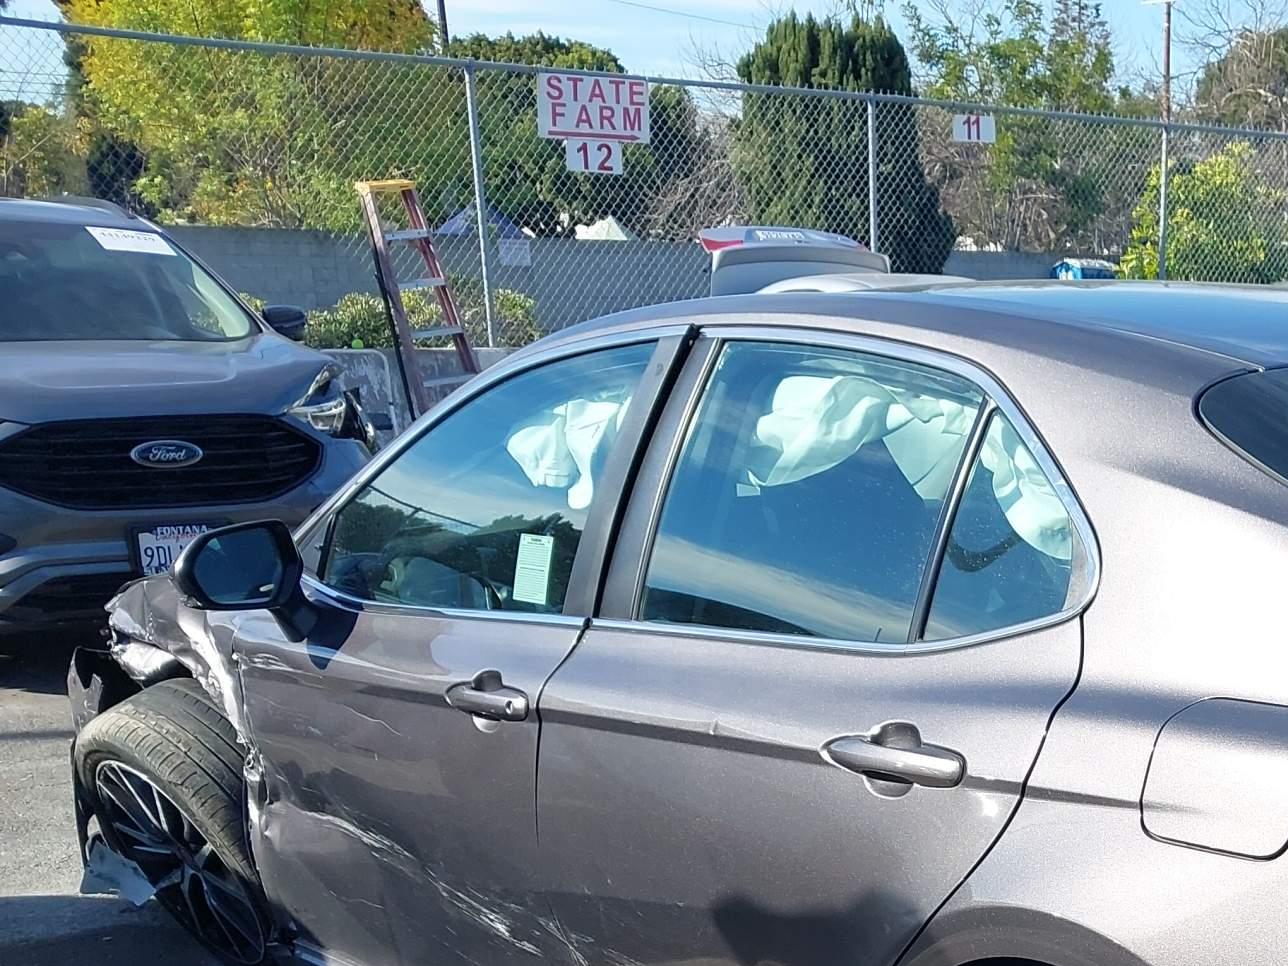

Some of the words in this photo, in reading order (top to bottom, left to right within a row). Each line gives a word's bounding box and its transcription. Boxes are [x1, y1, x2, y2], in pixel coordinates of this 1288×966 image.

[546, 75, 645, 107] STATE
[551, 102, 642, 131] FARM
[962, 115, 980, 140] 11
[577, 142, 614, 171] 12
[149, 446, 187, 461] Ford
[157, 524, 207, 537] FONTANA
